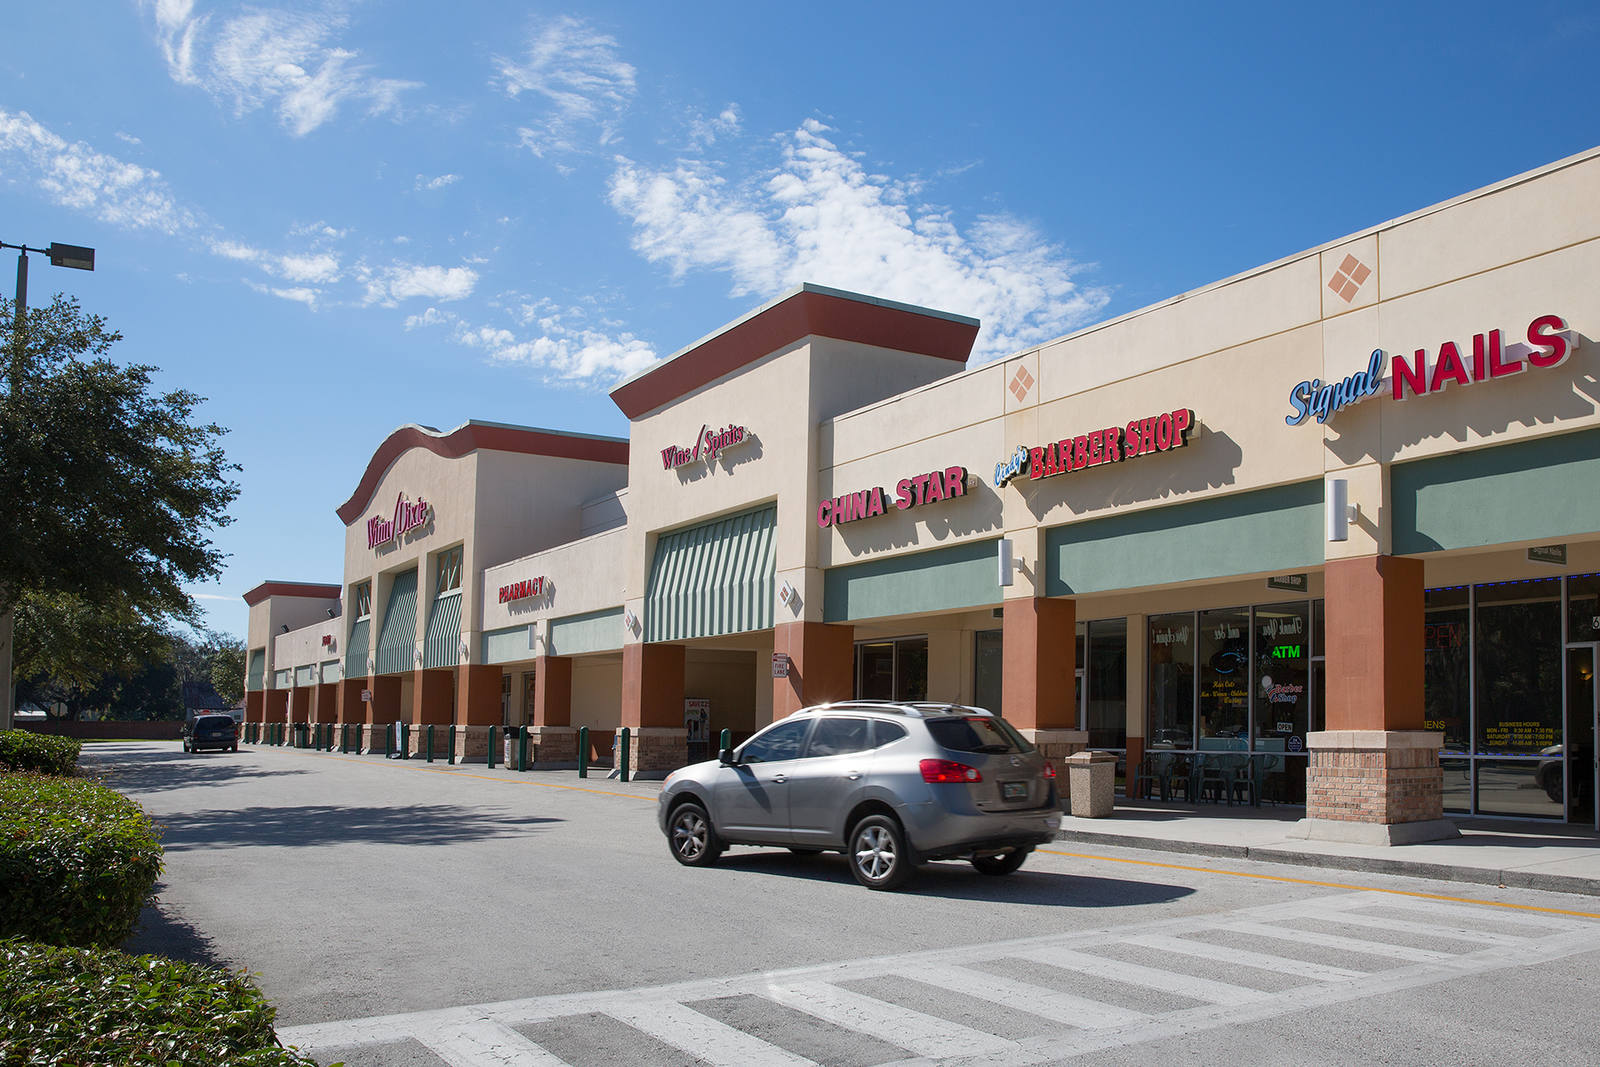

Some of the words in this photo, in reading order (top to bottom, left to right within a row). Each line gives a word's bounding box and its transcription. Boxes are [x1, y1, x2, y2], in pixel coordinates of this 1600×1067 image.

[1285, 349, 1383, 427] Signal
[1391, 314, 1568, 401] NAILS
[661, 445, 692, 470] Wine
[703, 424, 744, 460] Spirits
[1029, 426, 1121, 480] BARBER
[1124, 408, 1192, 459] SHOP
[396, 497, 428, 536] Dixie
[817, 487, 885, 528] CHINA
[896, 466, 967, 510] STAR
[498, 575, 545, 604] PHARMACY
[1271, 645, 1300, 659] ATM
[1424, 624, 1462, 649] PEN
[1278, 723, 1293, 731] OPEN
